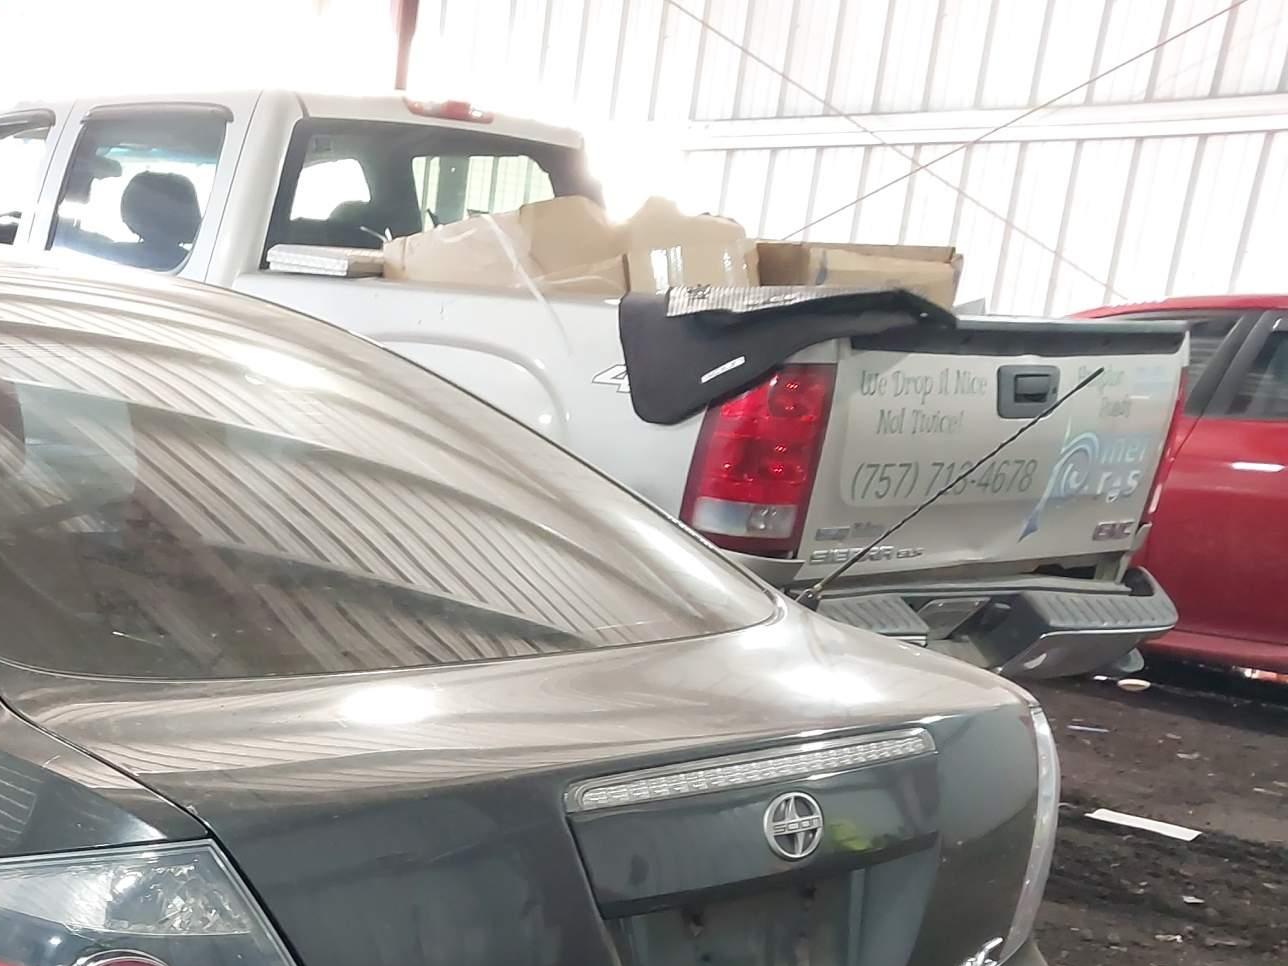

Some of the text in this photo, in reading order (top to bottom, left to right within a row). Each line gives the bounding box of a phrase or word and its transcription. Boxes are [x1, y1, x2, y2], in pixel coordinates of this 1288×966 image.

[861, 369, 887, 396] We
[893, 370, 934, 405] Drop
[954, 369, 989, 395] Nice
[851, 461, 919, 499] (757)
